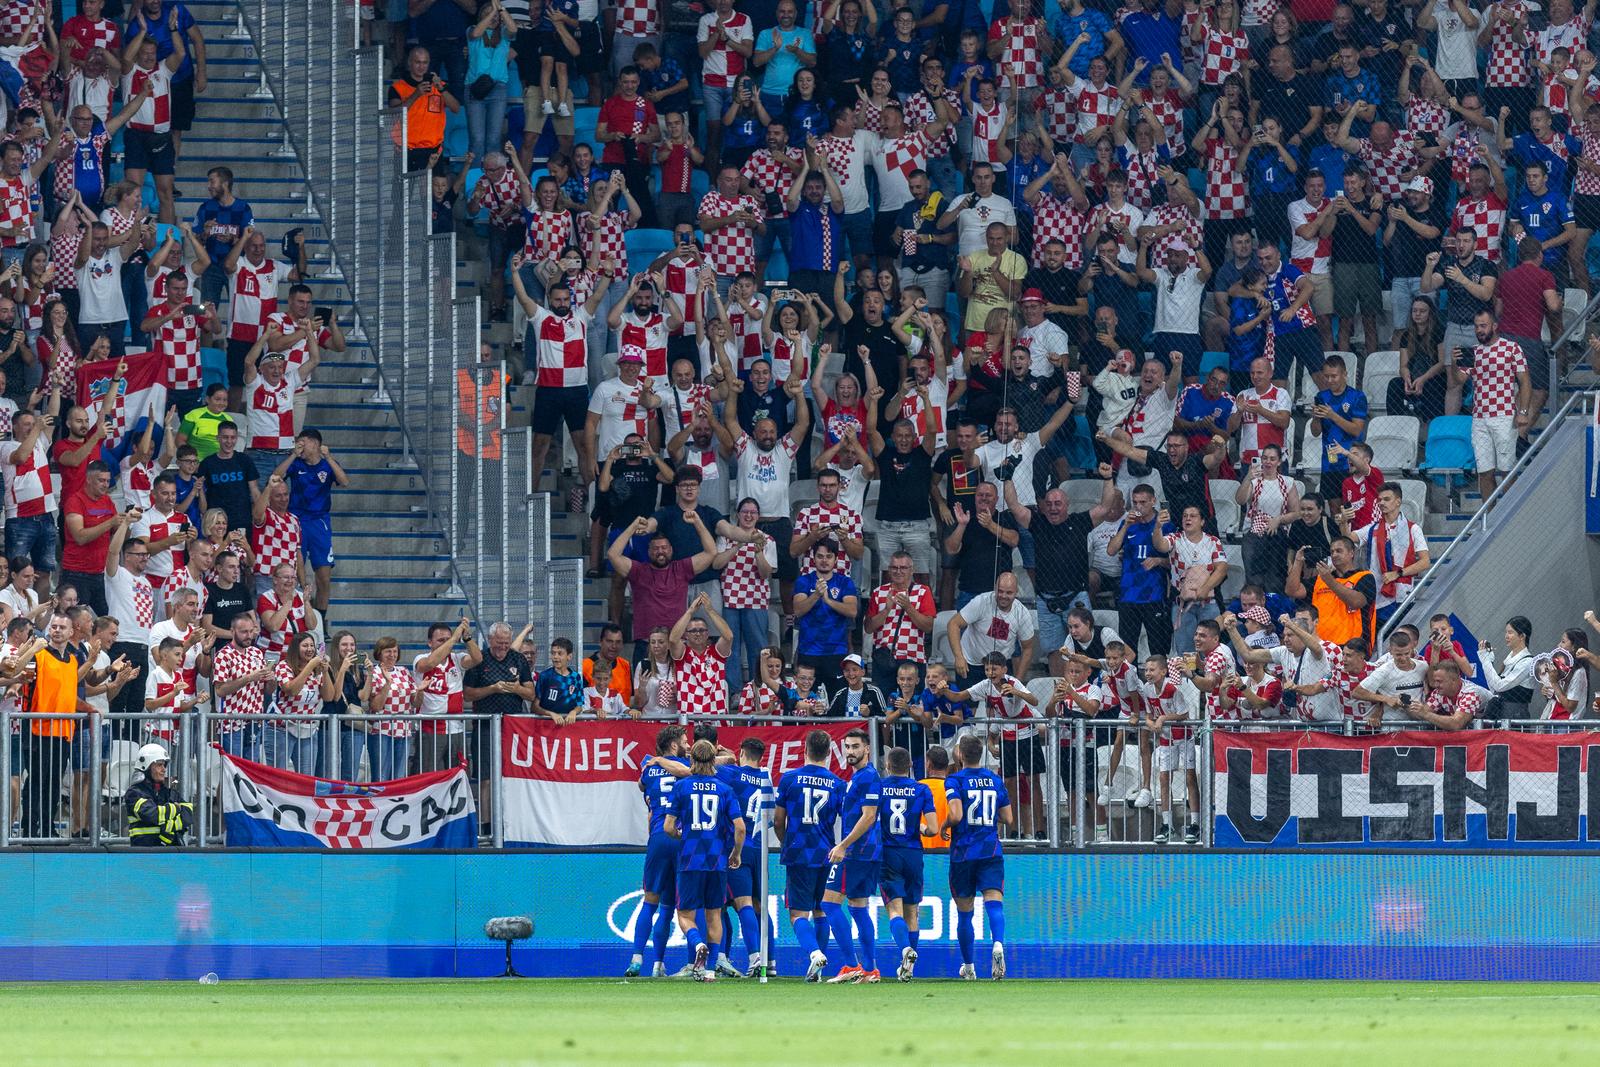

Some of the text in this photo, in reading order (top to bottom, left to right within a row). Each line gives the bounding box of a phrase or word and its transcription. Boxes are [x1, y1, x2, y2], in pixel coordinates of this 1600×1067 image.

[243, 46, 253, 59] 13
[263, 105, 273, 118] 12
[744, 120, 753, 135] 4
[803, 116, 811, 129] 4
[289, 165, 297, 177] 11
[1266, 167, 1273, 183] 4
[1529, 213, 1540, 227] 10
[311, 226, 321, 238] 10
[245, 281, 255, 294] 10
[336, 287, 342, 299] 9
[361, 349, 367, 361] 8
[264, 394, 275, 408] 10
[385, 412, 390, 424] 7
[211, 471, 244, 485] BOSS
[409, 477, 415, 489] 6
[433, 541, 440, 553] 5
[1137, 544, 1147, 559] 11
[428, 676, 444, 692] 24
[305, 690, 316, 704] 17
[548, 689, 558, 702] 10
[509, 733, 640, 775] UVIJEK
[692, 781, 717, 791] SOSA
[797, 774, 836, 789] PETKOVIĆ
[968, 777, 994, 788] PJACA
[882, 786, 917, 797] KOVAČIĆ
[690, 793, 720, 831] 19
[801, 787, 830, 825] 17
[967, 789, 998, 828] 20
[889, 798, 908, 835] 8
[830, 864, 839, 880] 6
